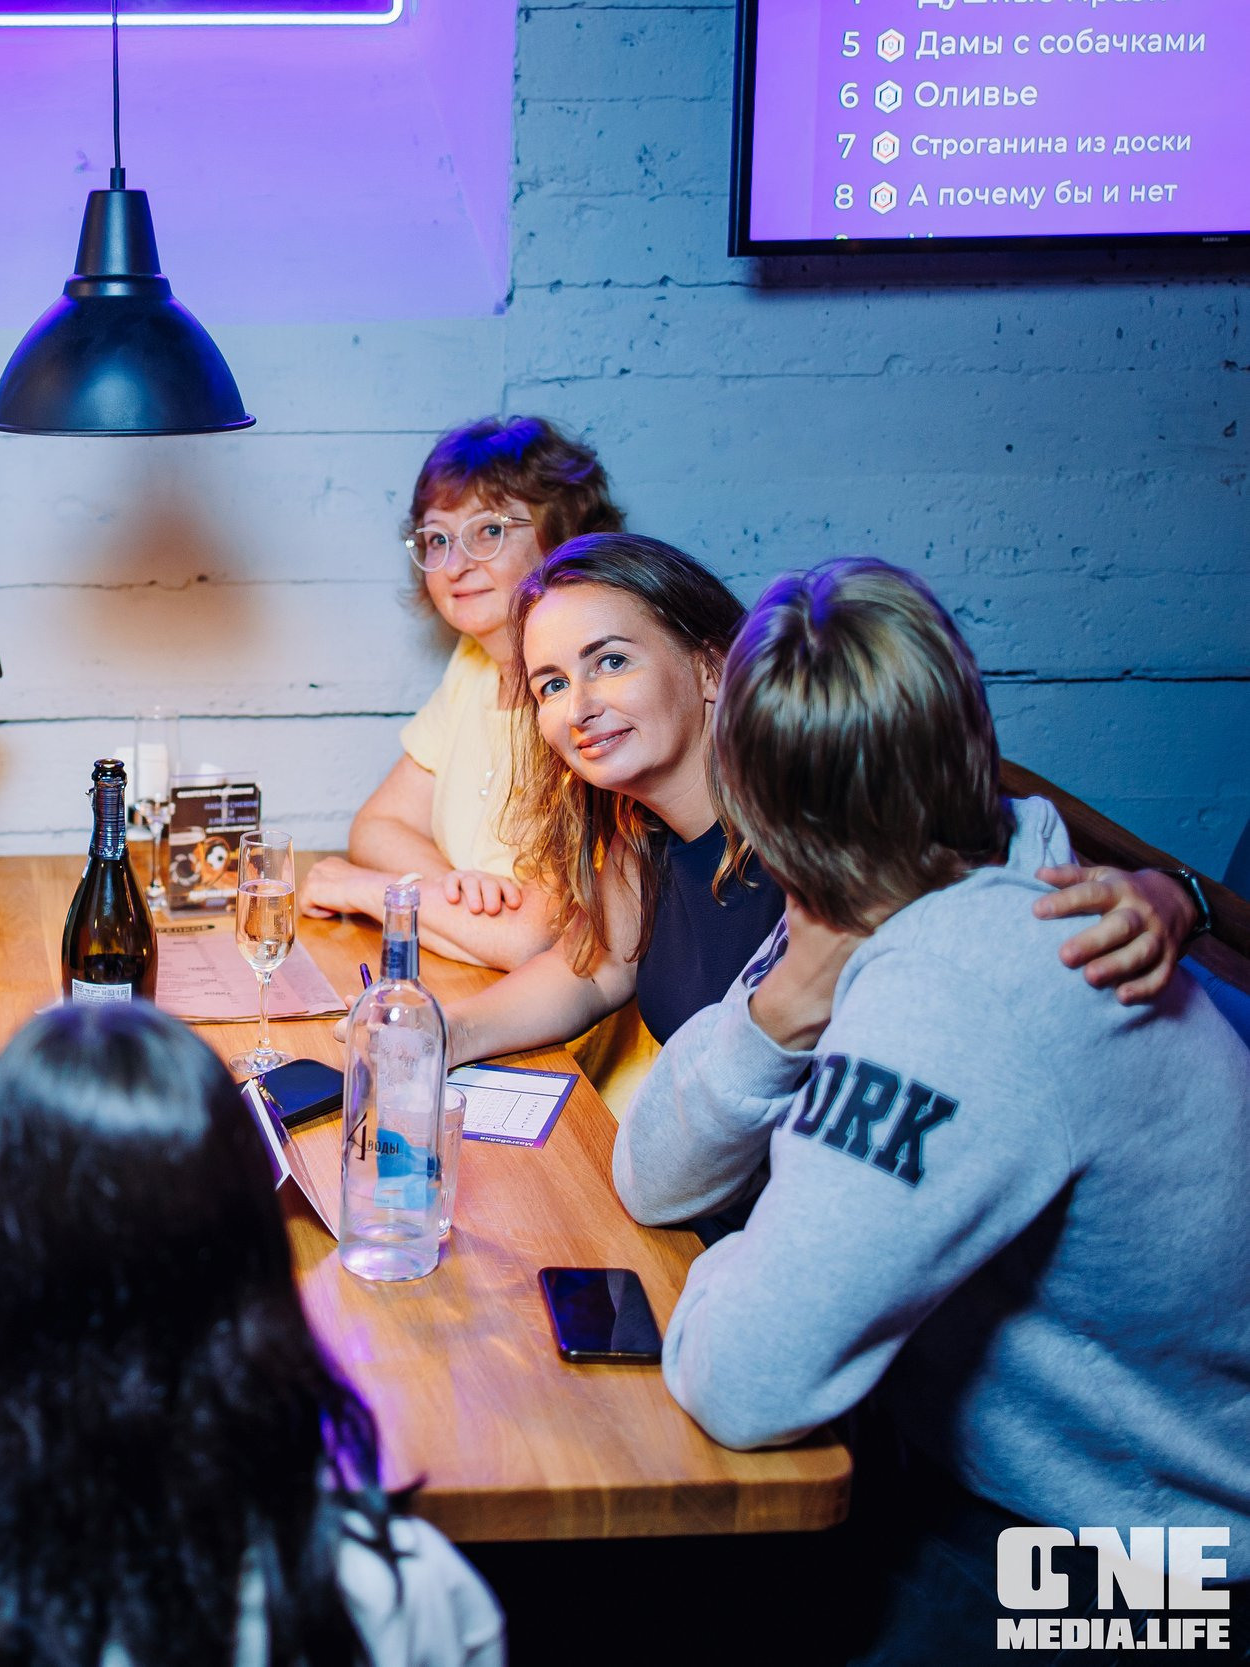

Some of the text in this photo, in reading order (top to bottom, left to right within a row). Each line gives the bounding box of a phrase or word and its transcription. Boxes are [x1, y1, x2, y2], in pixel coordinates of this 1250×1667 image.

[842, 27, 1207, 60] 5 Дамы с собачками
[840, 81, 1038, 109] 6 Оливье
[838, 133, 1191, 160] 7 Строганина из доски
[835, 179, 1178, 210] 8 А почему бы и нет
[776, 1052, 960, 1187] ORK
